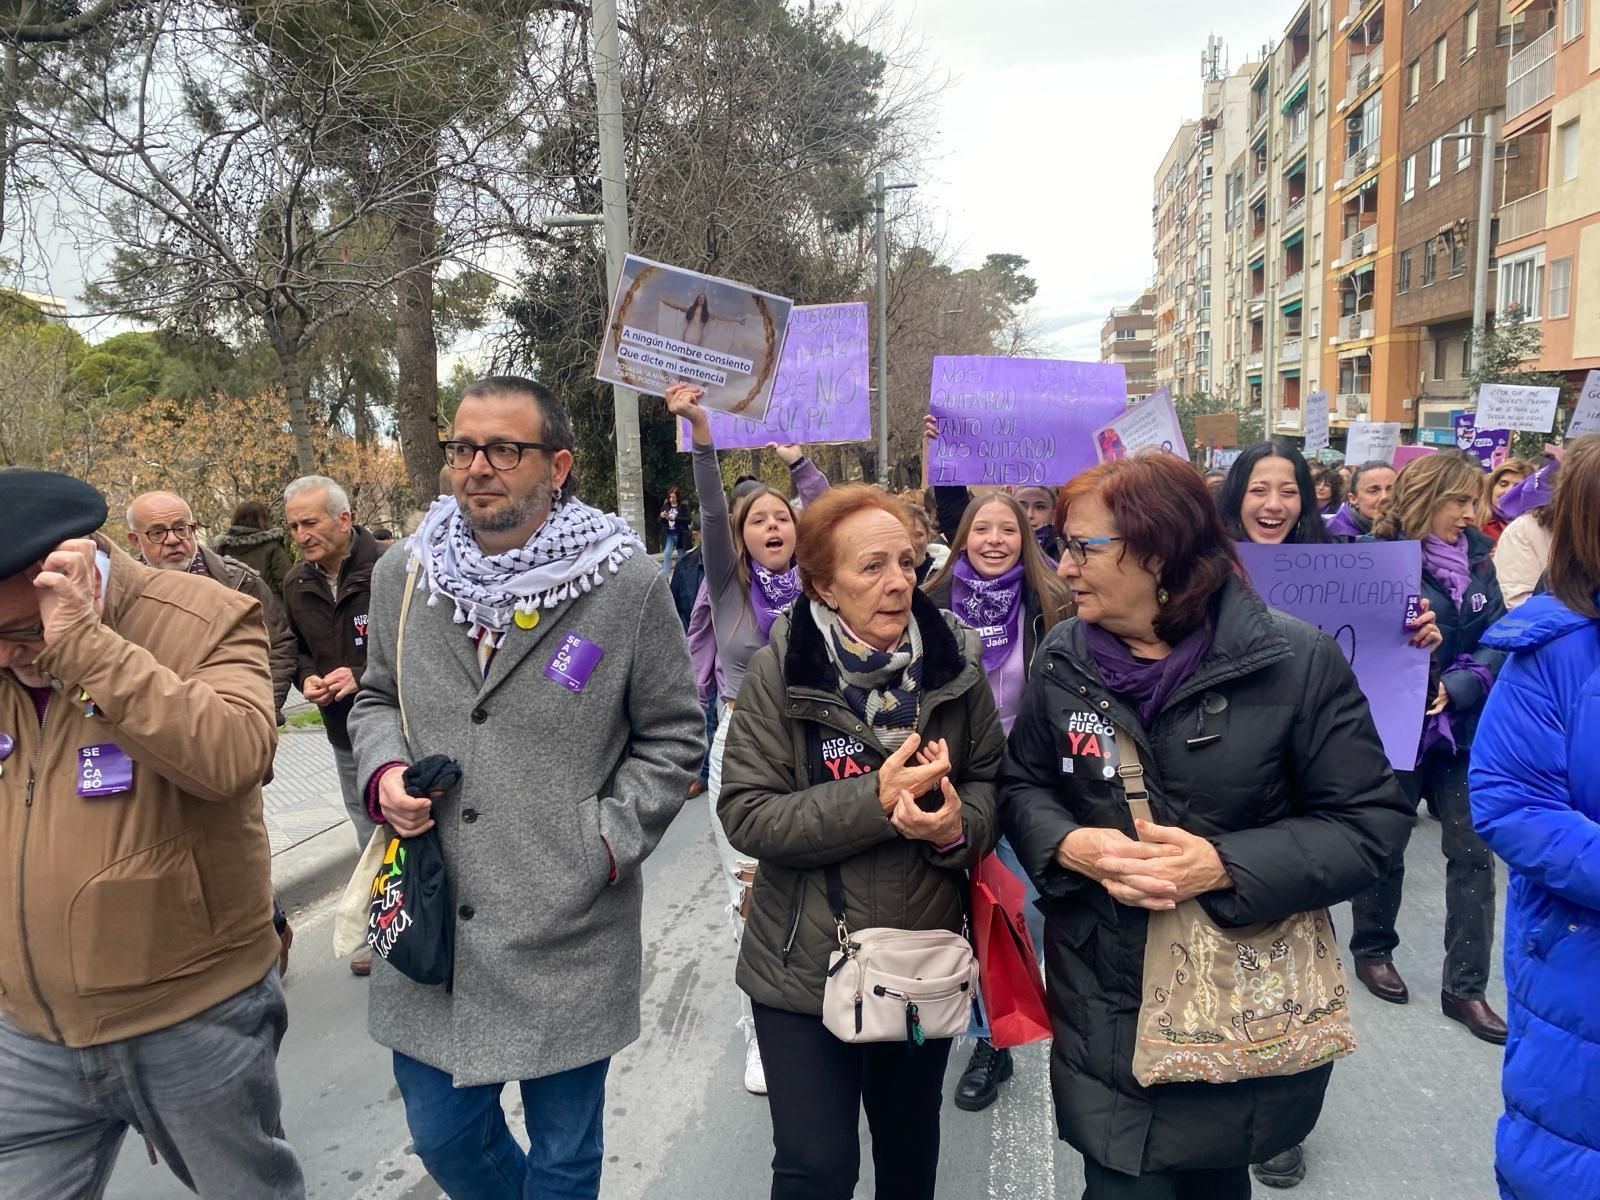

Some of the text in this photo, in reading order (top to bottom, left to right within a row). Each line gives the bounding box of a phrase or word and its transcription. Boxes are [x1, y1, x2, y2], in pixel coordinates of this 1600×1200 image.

[623, 329, 751, 372] A ningún hombre consiento
[619, 346, 639, 359] Que
[640, 353, 664, 367] dicte
[665, 361, 677, 371] mi
[679, 366, 725, 384] sentencia
[943, 360, 983, 384] NOS
[774, 367, 858, 405] QUE NO
[933, 386, 1017, 411] QUITARON
[765, 405, 833, 434] CULPA
[936, 416, 982, 437] TANTO
[936, 433, 1056, 459] NOS QUITARON
[936, 460, 1047, 485] EL MIEDO
[562, 644, 570, 653] A
[567, 635, 581, 648] SE
[986, 636, 1009, 648] Jaén
[557, 652, 571, 664] CA
[1070, 712, 1099, 722] ALTO
[1068, 721, 1115, 737] FUEGO
[82, 747, 100, 757] SE
[822, 737, 846, 751] ALTO
[822, 743, 864, 761] FUEGO
[1068, 732, 1112, 760] YA.
[83, 759, 93, 768] A
[825, 756, 871, 780] YA.
[82, 777, 102, 789] BÓ
[83, 769, 103, 779] CA
